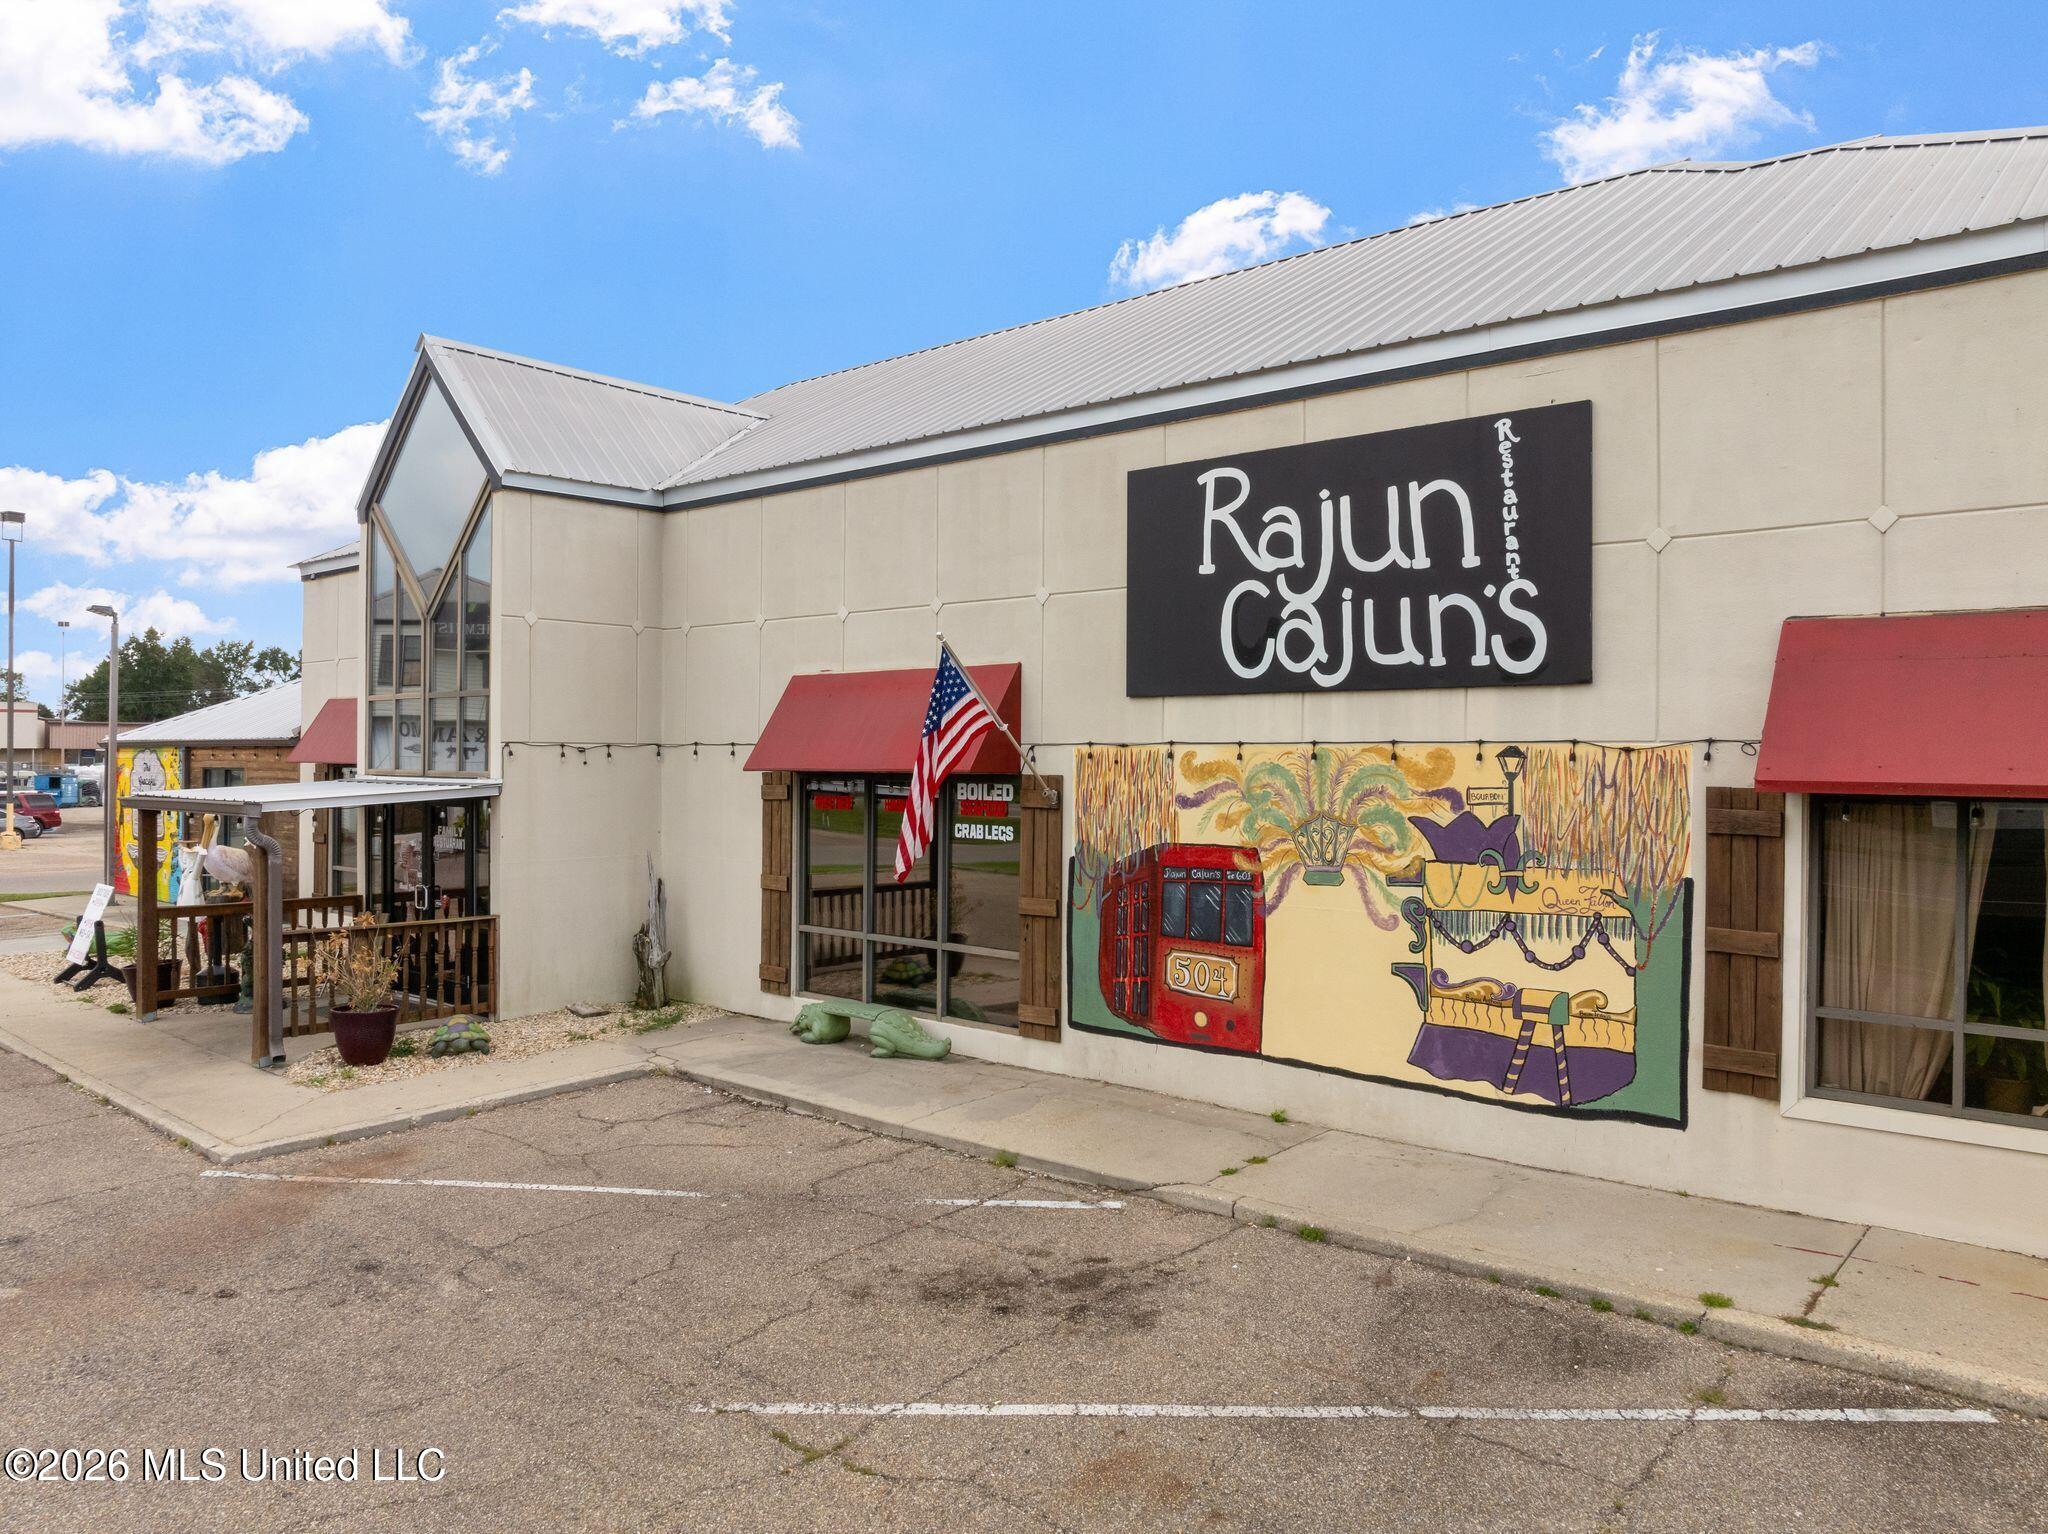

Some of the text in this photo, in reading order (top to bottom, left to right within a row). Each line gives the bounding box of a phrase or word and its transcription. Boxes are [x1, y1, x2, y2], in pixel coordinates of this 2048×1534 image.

[1494, 418, 1520, 580] Restaurant
[1197, 467, 1480, 601] Rajun
[957, 783, 1014, 801] BOILED
[1471, 793, 1504, 801] BOURBON
[437, 825, 464, 837] FAMILY
[954, 823, 1014, 842] CRAB LEGS
[1539, 887, 1580, 914] Queen
[1174, 958, 1228, 997] 504
